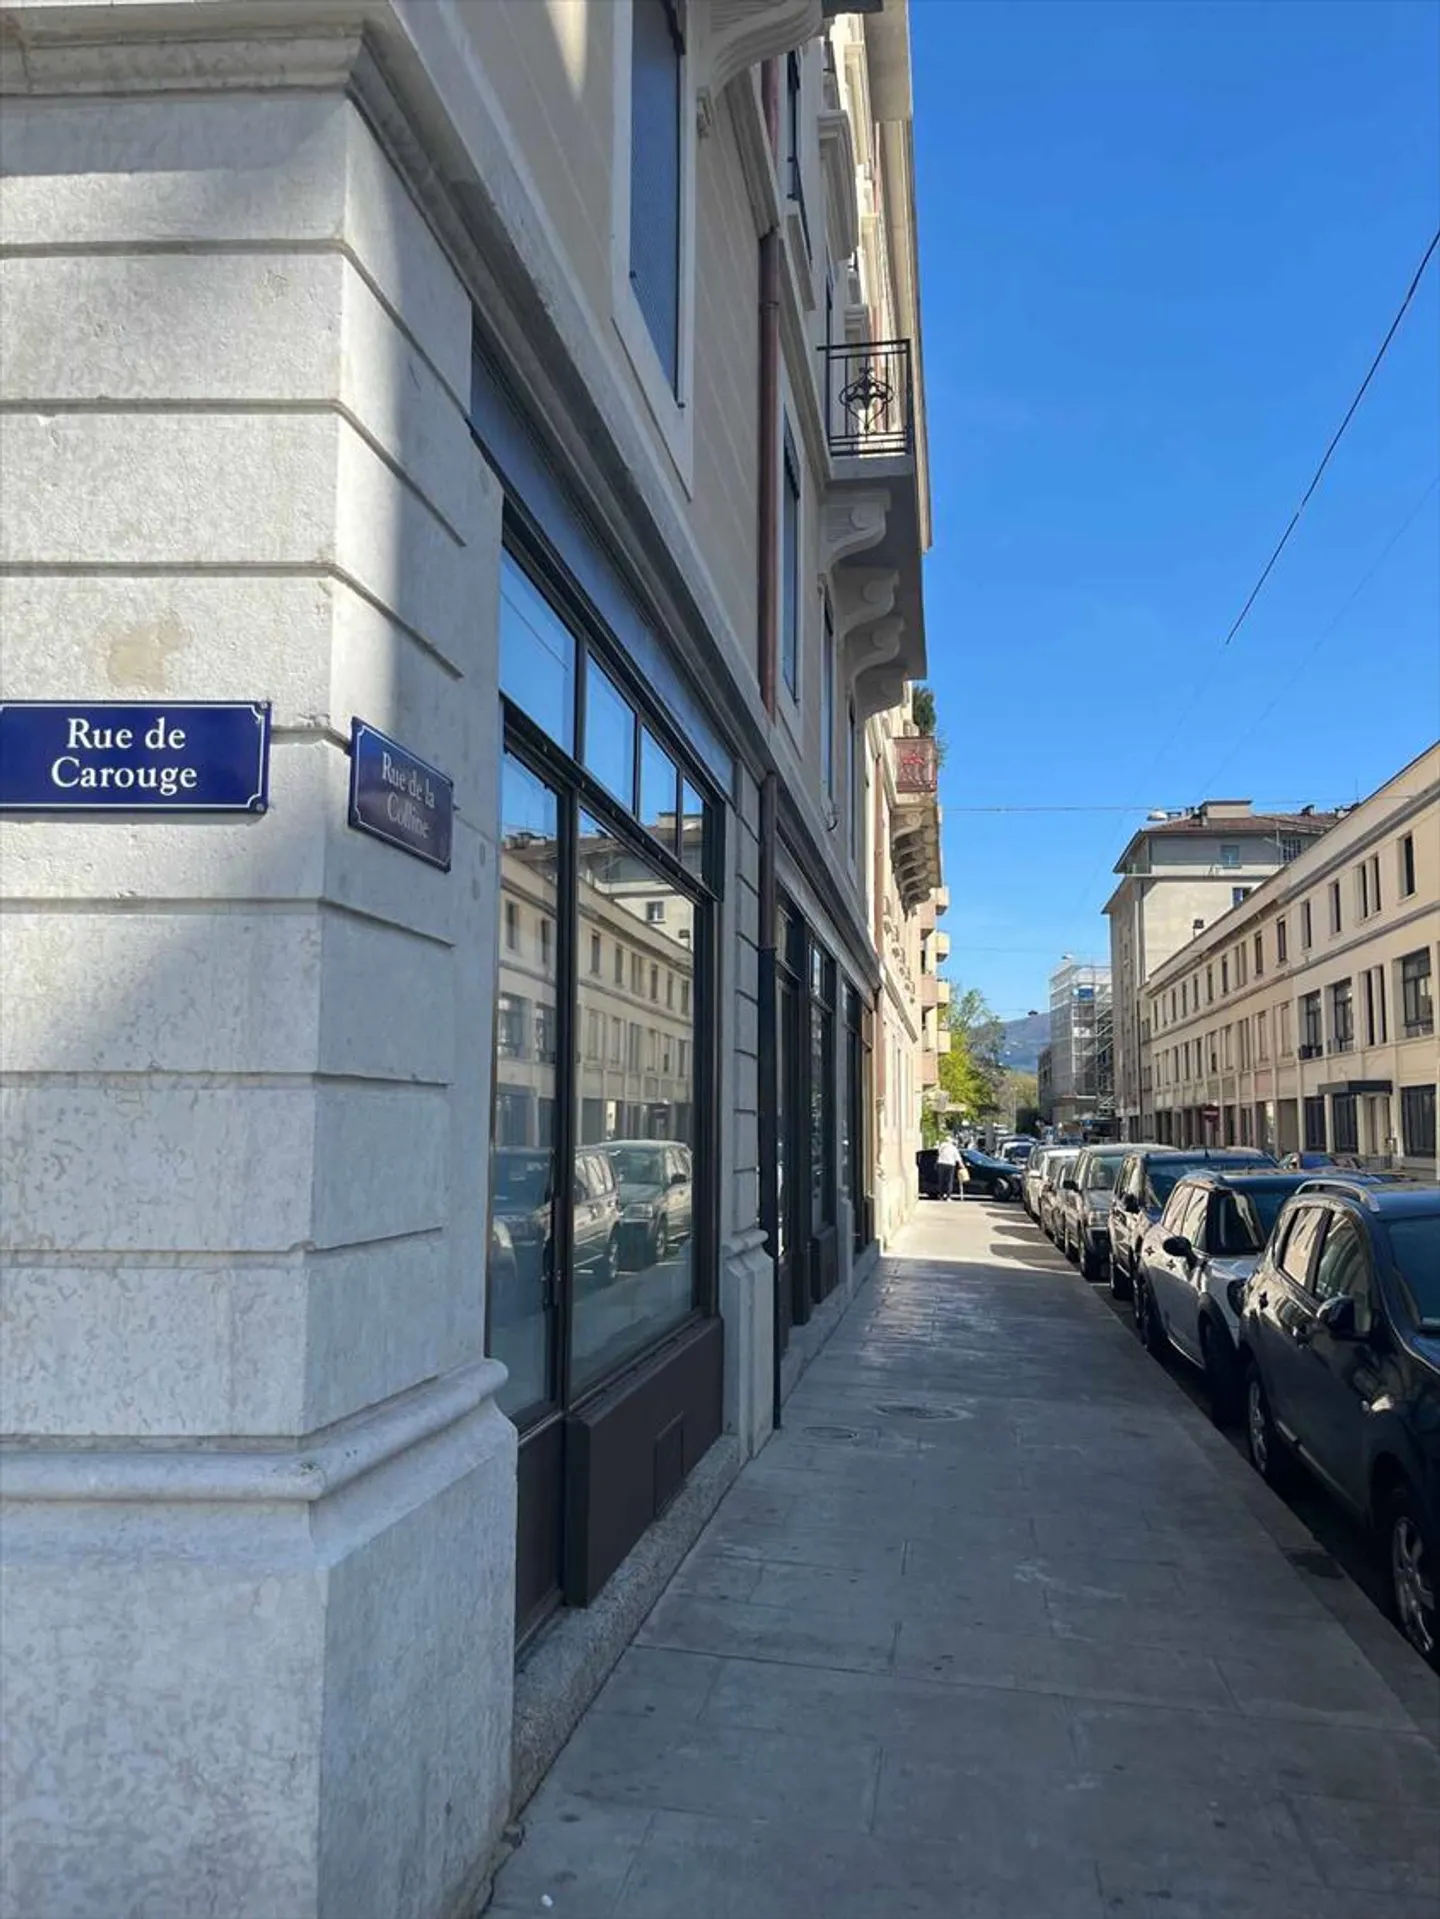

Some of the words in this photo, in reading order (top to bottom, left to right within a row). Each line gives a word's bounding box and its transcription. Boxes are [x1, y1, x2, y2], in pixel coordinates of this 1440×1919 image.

[67, 717, 133, 749] Rue
[144, 717, 186, 749] de
[51, 756, 198, 796] Carouge
[382, 751, 406, 791] Rue
[408, 771, 422, 801] de
[425, 778, 435, 809] la
[387, 792, 429, 838] Colline
